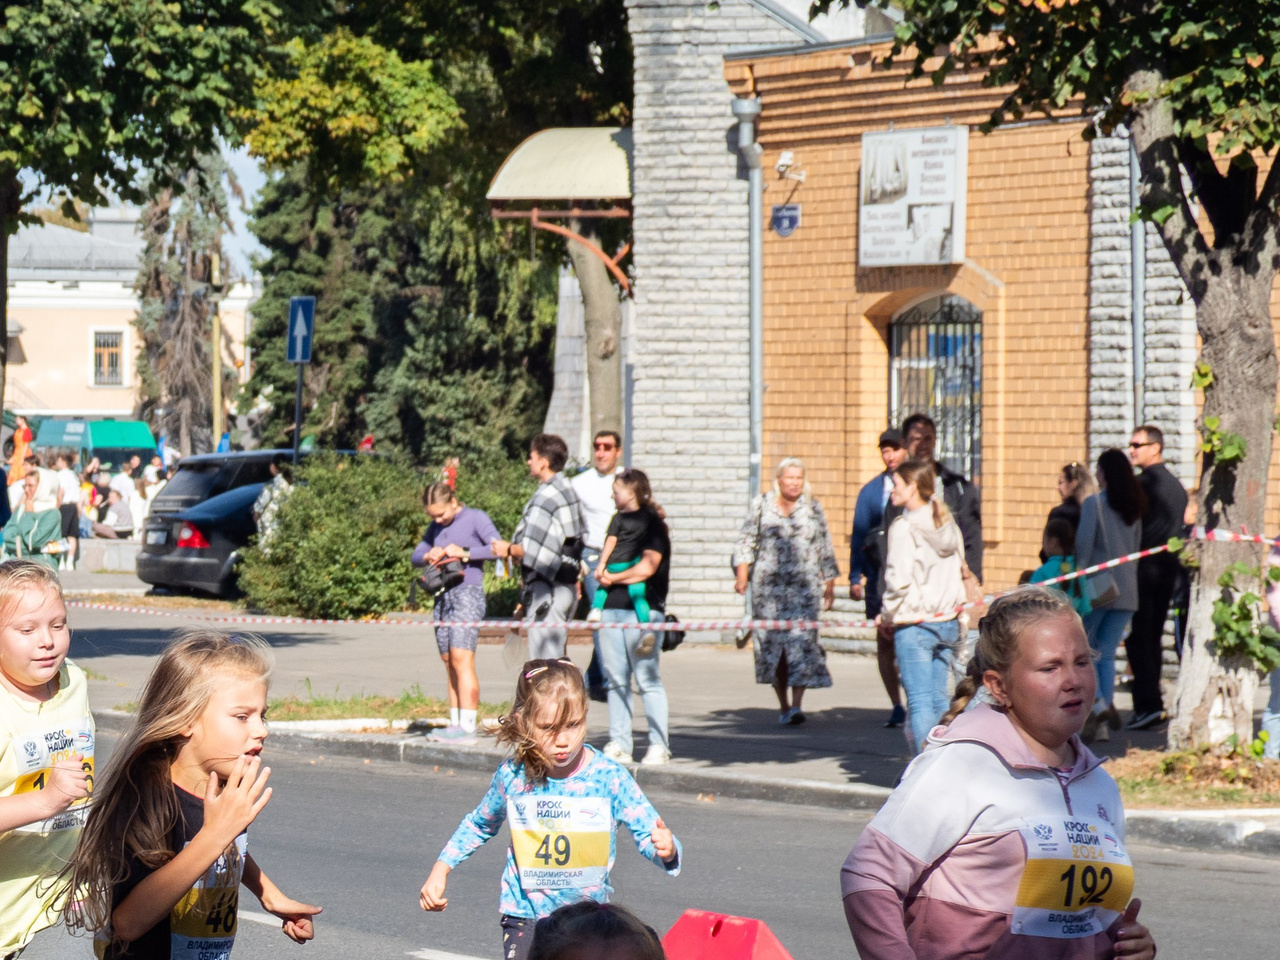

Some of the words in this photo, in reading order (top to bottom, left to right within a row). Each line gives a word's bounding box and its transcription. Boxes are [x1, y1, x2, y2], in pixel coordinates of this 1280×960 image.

[43, 730, 66, 743] КРОСС
[47, 738, 74, 753] НАЦИИ
[536, 800, 562, 809] КРОСС
[536, 810, 571, 819] НАЦИИ
[1063, 821, 1091, 834] КРОСС
[1066, 832, 1101, 846] НАЦИИ
[535, 834, 571, 866] 49
[1071, 845, 1105, 860] 2024
[523, 870, 583, 879] ВЛАДИМИРСКАЯ
[535, 878, 571, 887] ОБЛАСТЬ
[1060, 864, 1114, 907] 192
